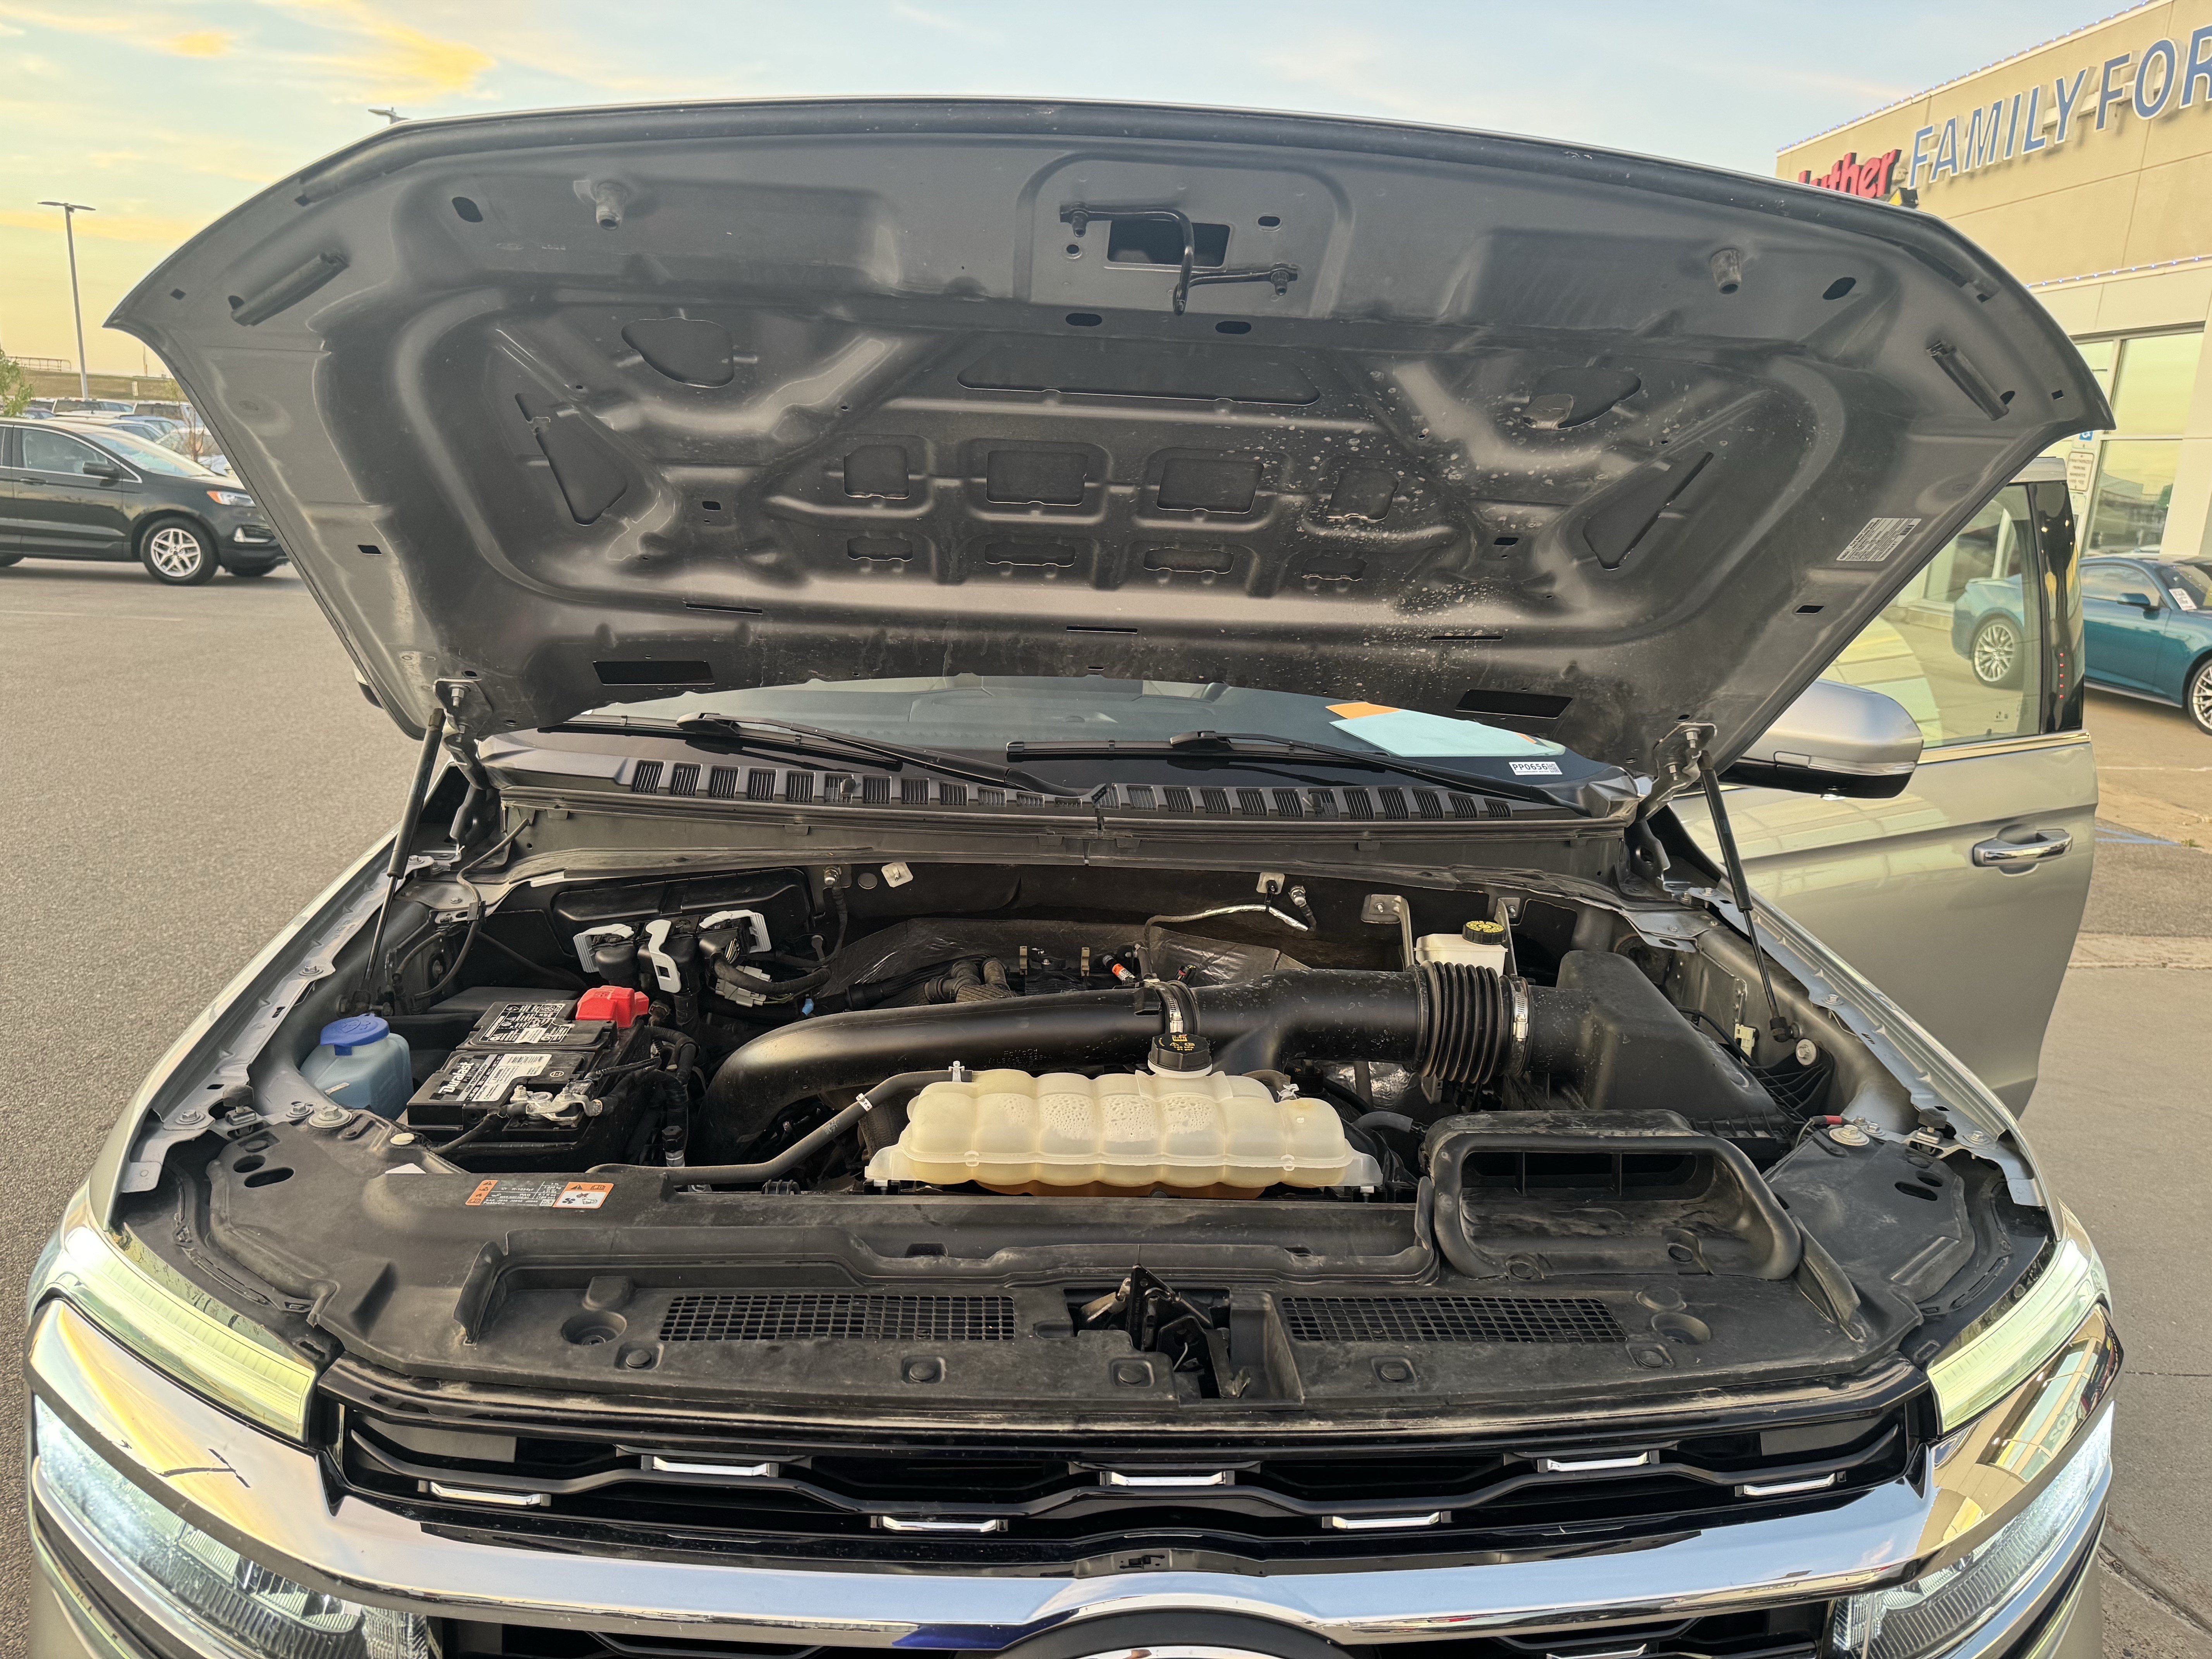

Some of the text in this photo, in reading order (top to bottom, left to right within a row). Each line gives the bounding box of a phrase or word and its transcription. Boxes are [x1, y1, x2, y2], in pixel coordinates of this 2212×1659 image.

[1798, 24, 2212, 198] ther FAMILY FOR
[438, 1062, 475, 1094] Duralast
